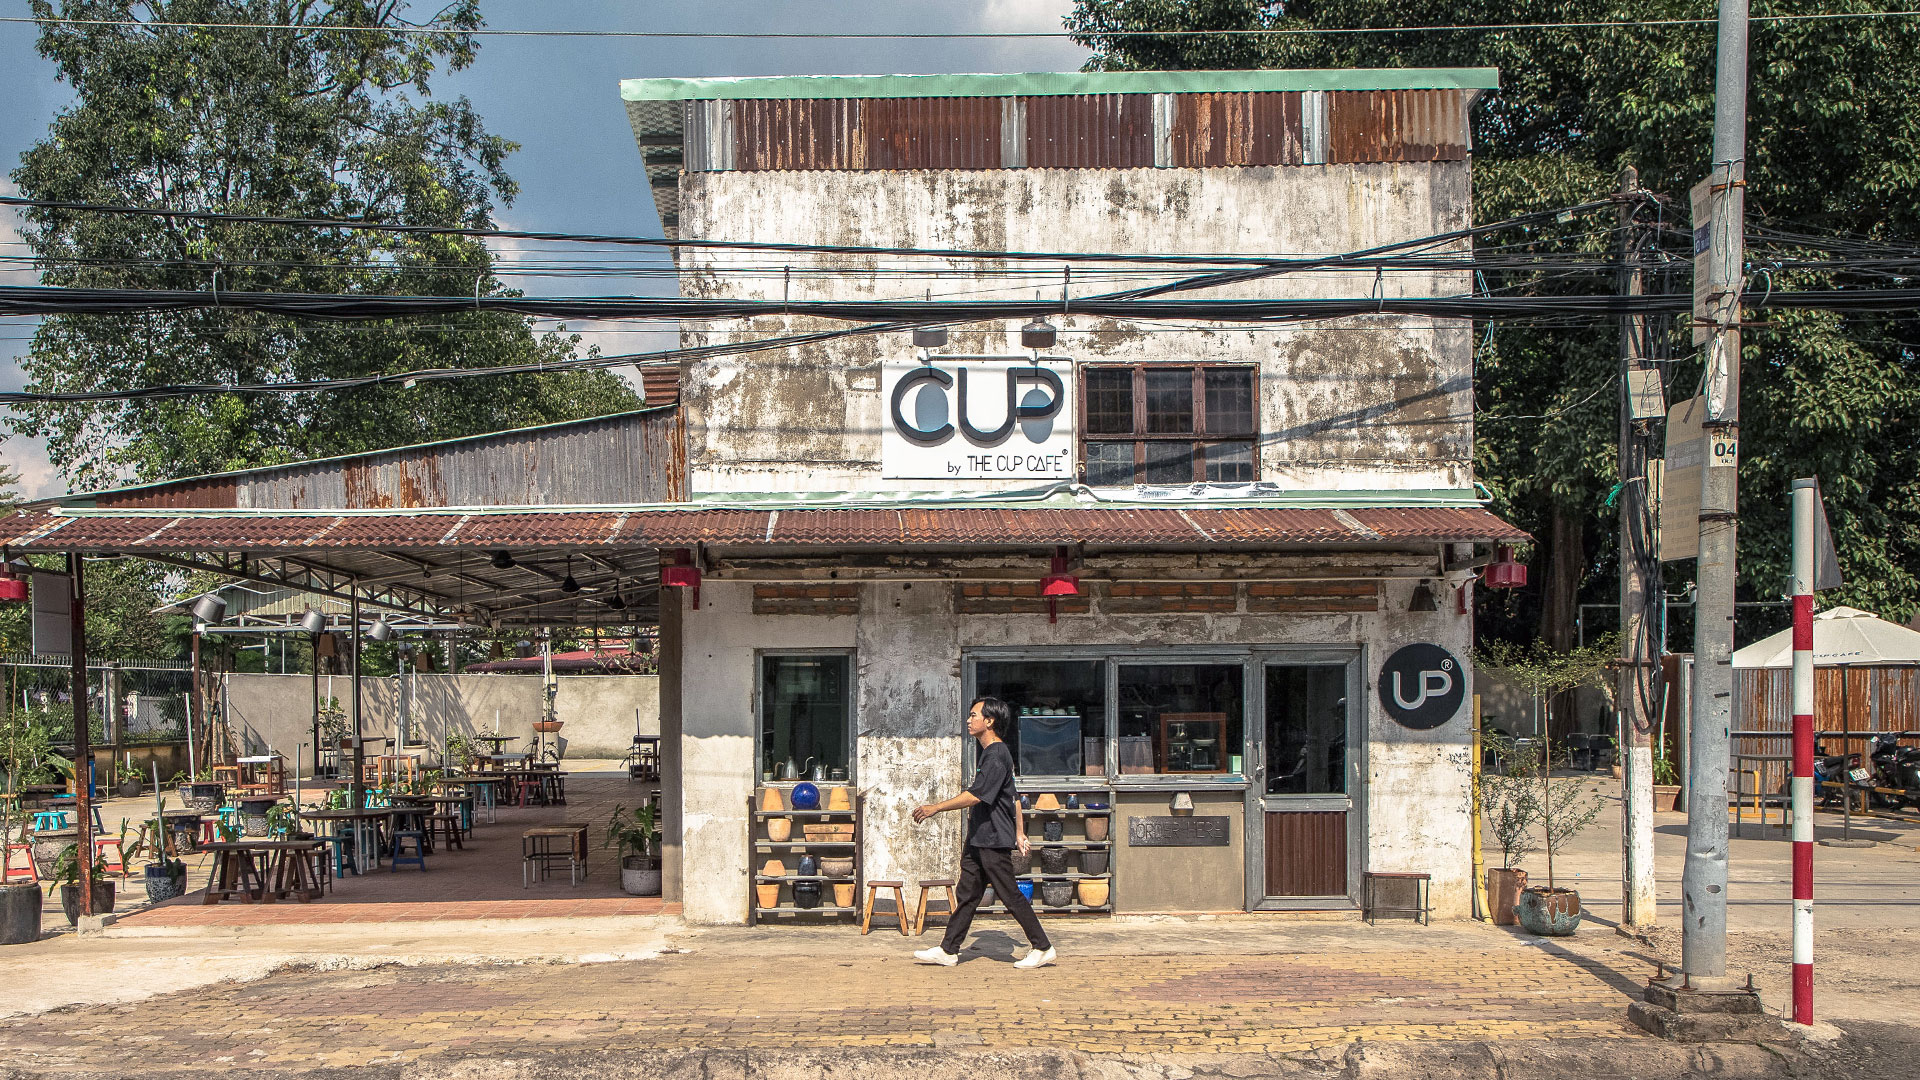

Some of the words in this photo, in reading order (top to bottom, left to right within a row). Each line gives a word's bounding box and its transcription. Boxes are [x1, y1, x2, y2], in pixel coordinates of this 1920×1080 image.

[891, 366, 1064, 447] CUP
[1714, 442, 1736, 457] 04
[947, 461, 962, 475] by
[967, 455, 992, 472] THE
[997, 455, 1023, 472] CUP
[1136, 821, 1180, 839] ORDER
[1186, 821, 1223, 839] HERE
